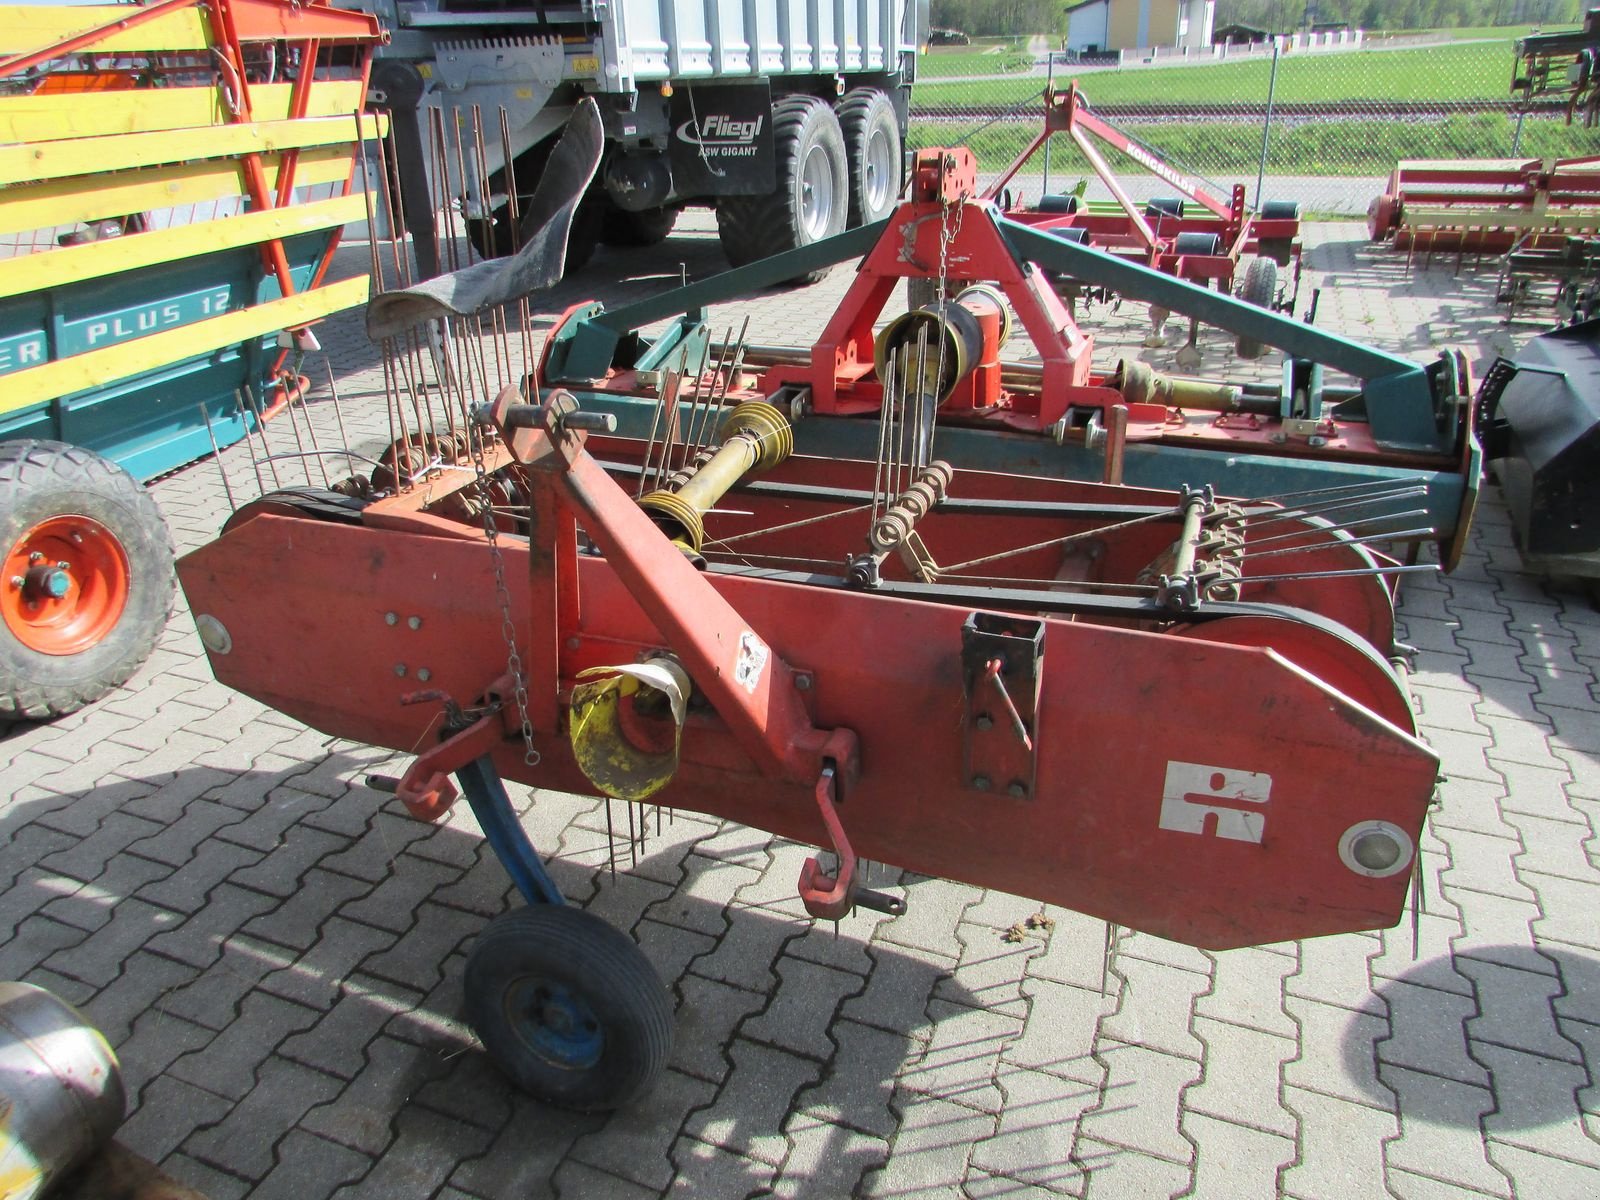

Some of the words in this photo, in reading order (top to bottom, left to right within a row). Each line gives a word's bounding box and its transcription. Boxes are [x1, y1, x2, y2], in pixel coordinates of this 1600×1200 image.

[702, 115, 763, 140] Fliegl
[721, 147, 757, 156] GIGANT
[1126, 142, 1195, 196] KONGSKILDE
[87, 304, 180, 345] PLUS
[202, 292, 230, 314] 12
